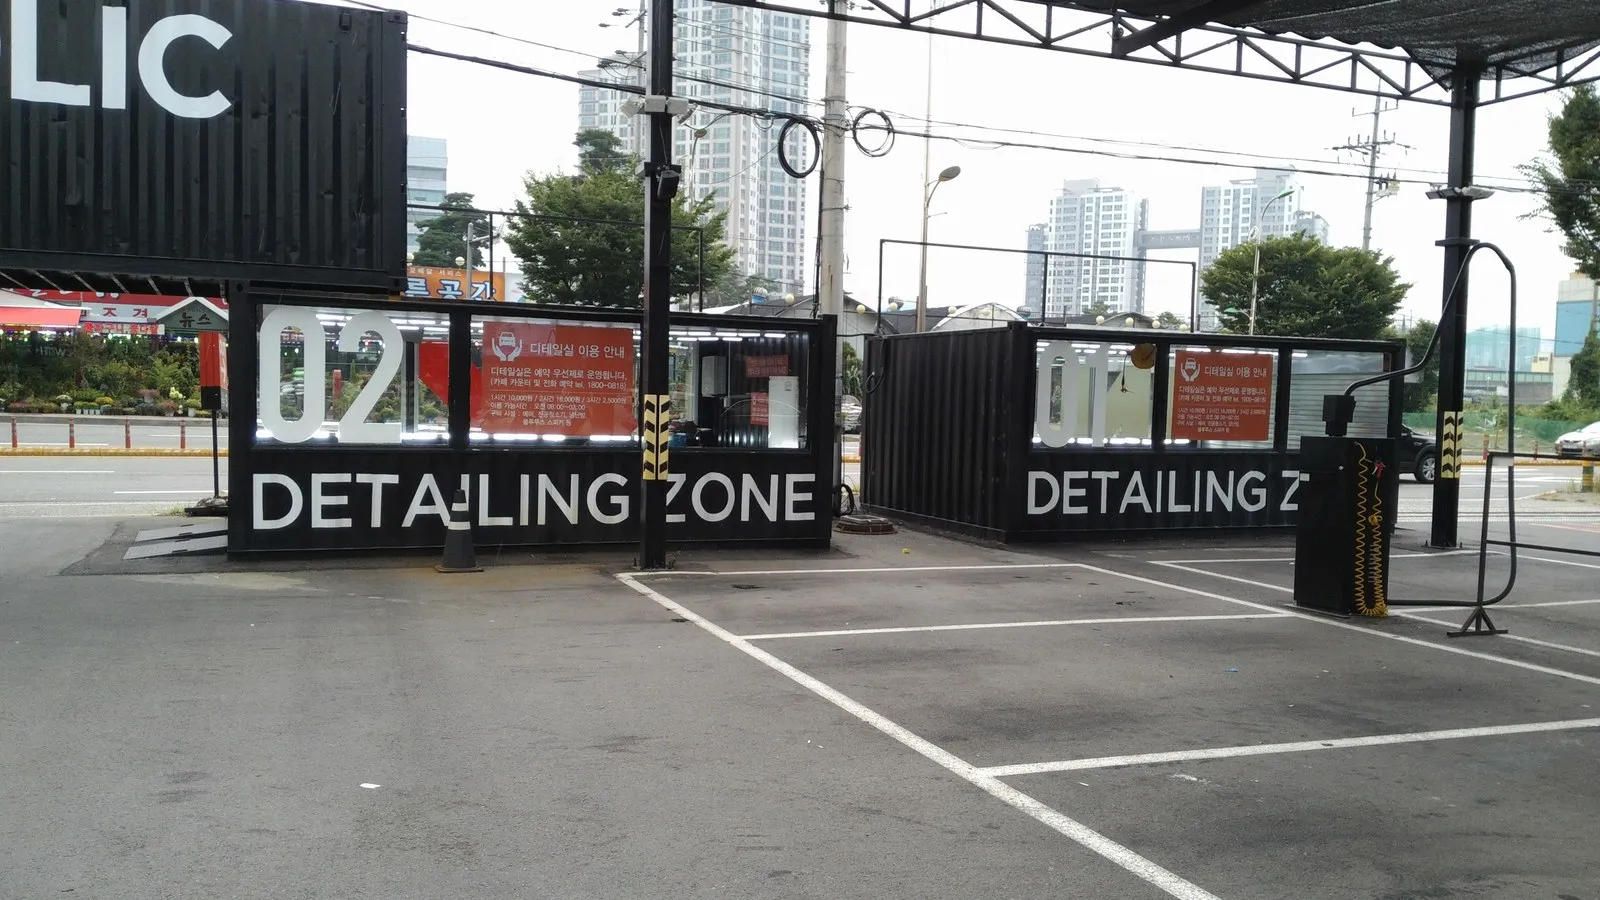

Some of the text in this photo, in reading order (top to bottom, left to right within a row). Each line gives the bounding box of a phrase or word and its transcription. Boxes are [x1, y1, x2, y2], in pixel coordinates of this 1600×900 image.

[179, 312, 212, 328] 뉴스
[530, 342, 625, 358] 디테일실 이용 안내
[260, 306, 403, 443] 02
[490, 366, 532, 378] 디테일실은
[534, 368, 550, 378] 예약
[553, 368, 584, 379] 우선제로
[1204, 366, 1266, 378] 디테일실 이용 안내
[490, 378, 508, 387] (카페
[510, 378, 530, 387] 카운터
[534, 378, 541, 388] 및
[543, 380, 557, 388] 전화
[560, 380, 573, 388] 예약
[1036, 341, 1108, 447] 01
[666, 472, 816, 522] ZONE
[1027, 470, 1267, 514] DETAILING
